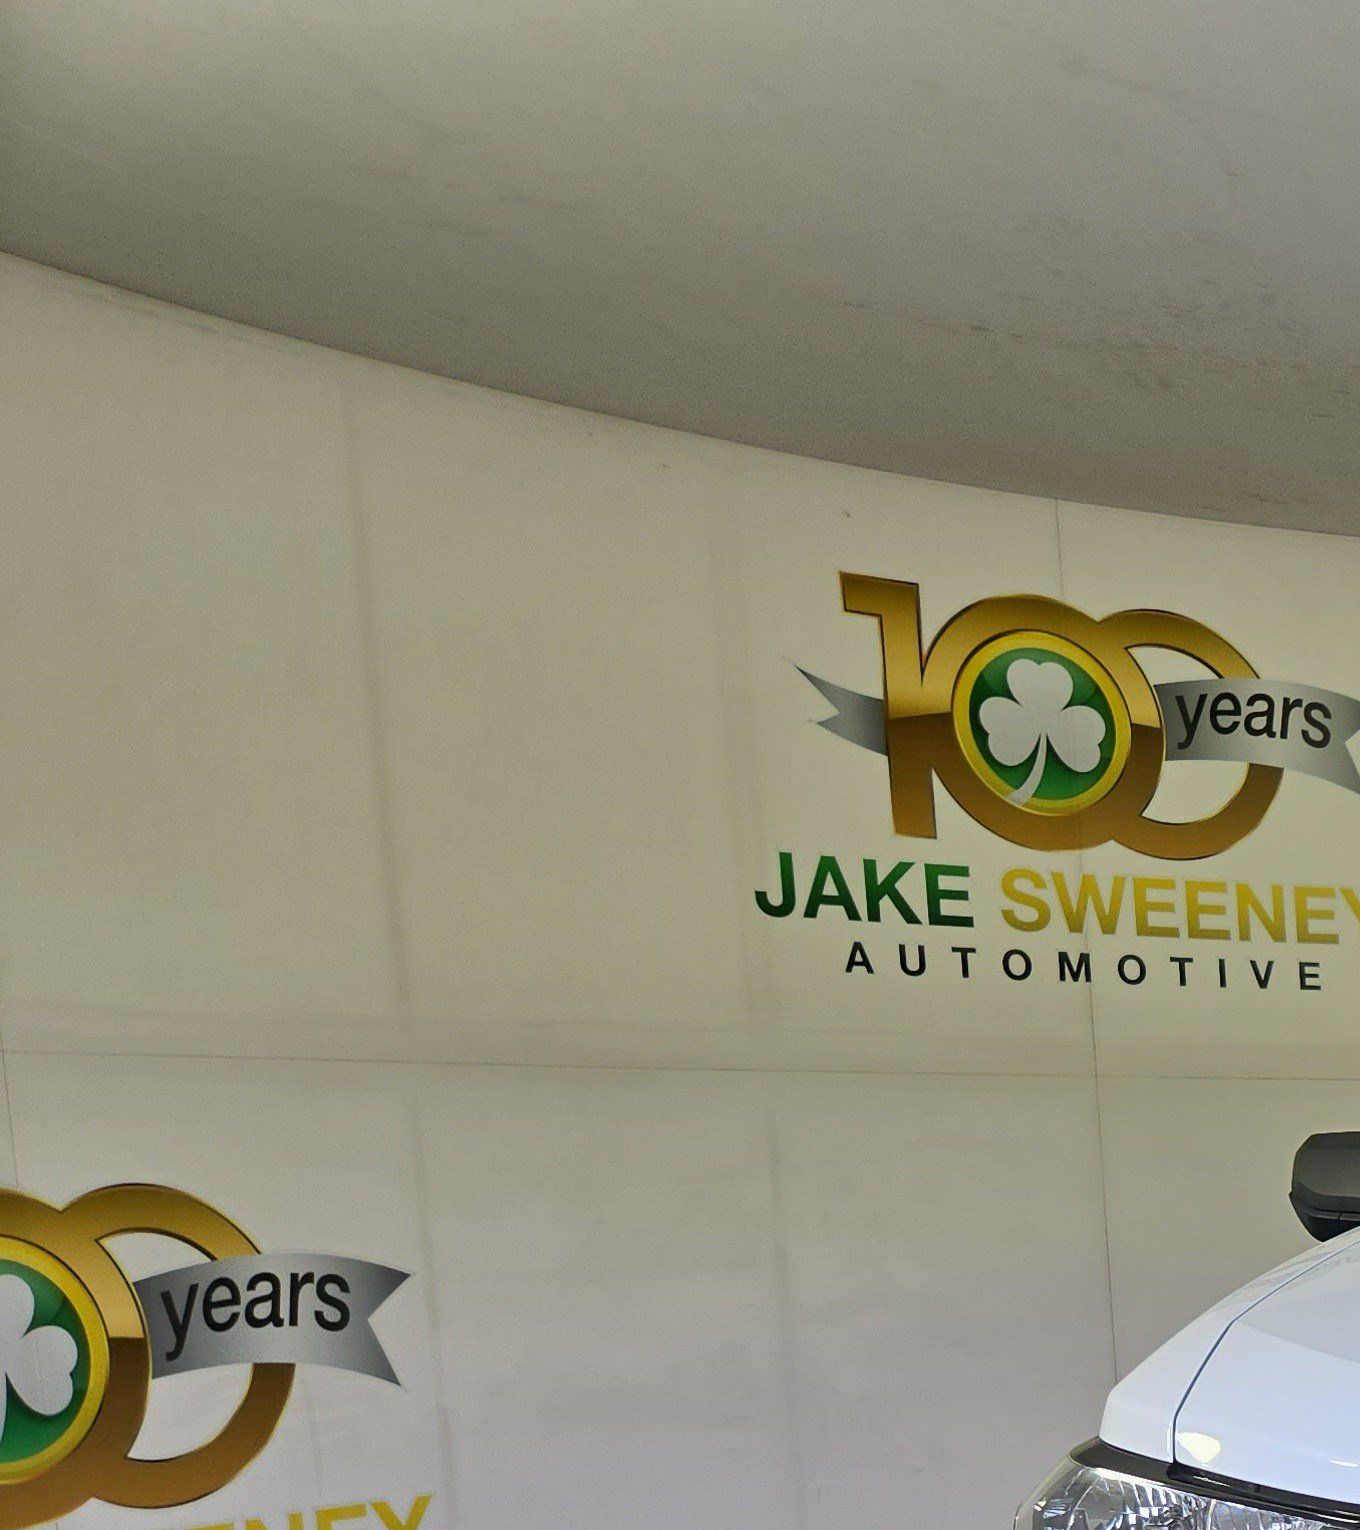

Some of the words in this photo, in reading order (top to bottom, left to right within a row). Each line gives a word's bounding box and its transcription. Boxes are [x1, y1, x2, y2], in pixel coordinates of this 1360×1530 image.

[837, 571, 1285, 861] 100
[1175, 691, 1334, 750] years
[754, 850, 975, 929] JAKE
[844, 940, 1323, 992] AUTOMOTIVE
[160, 1270, 352, 1362] years
